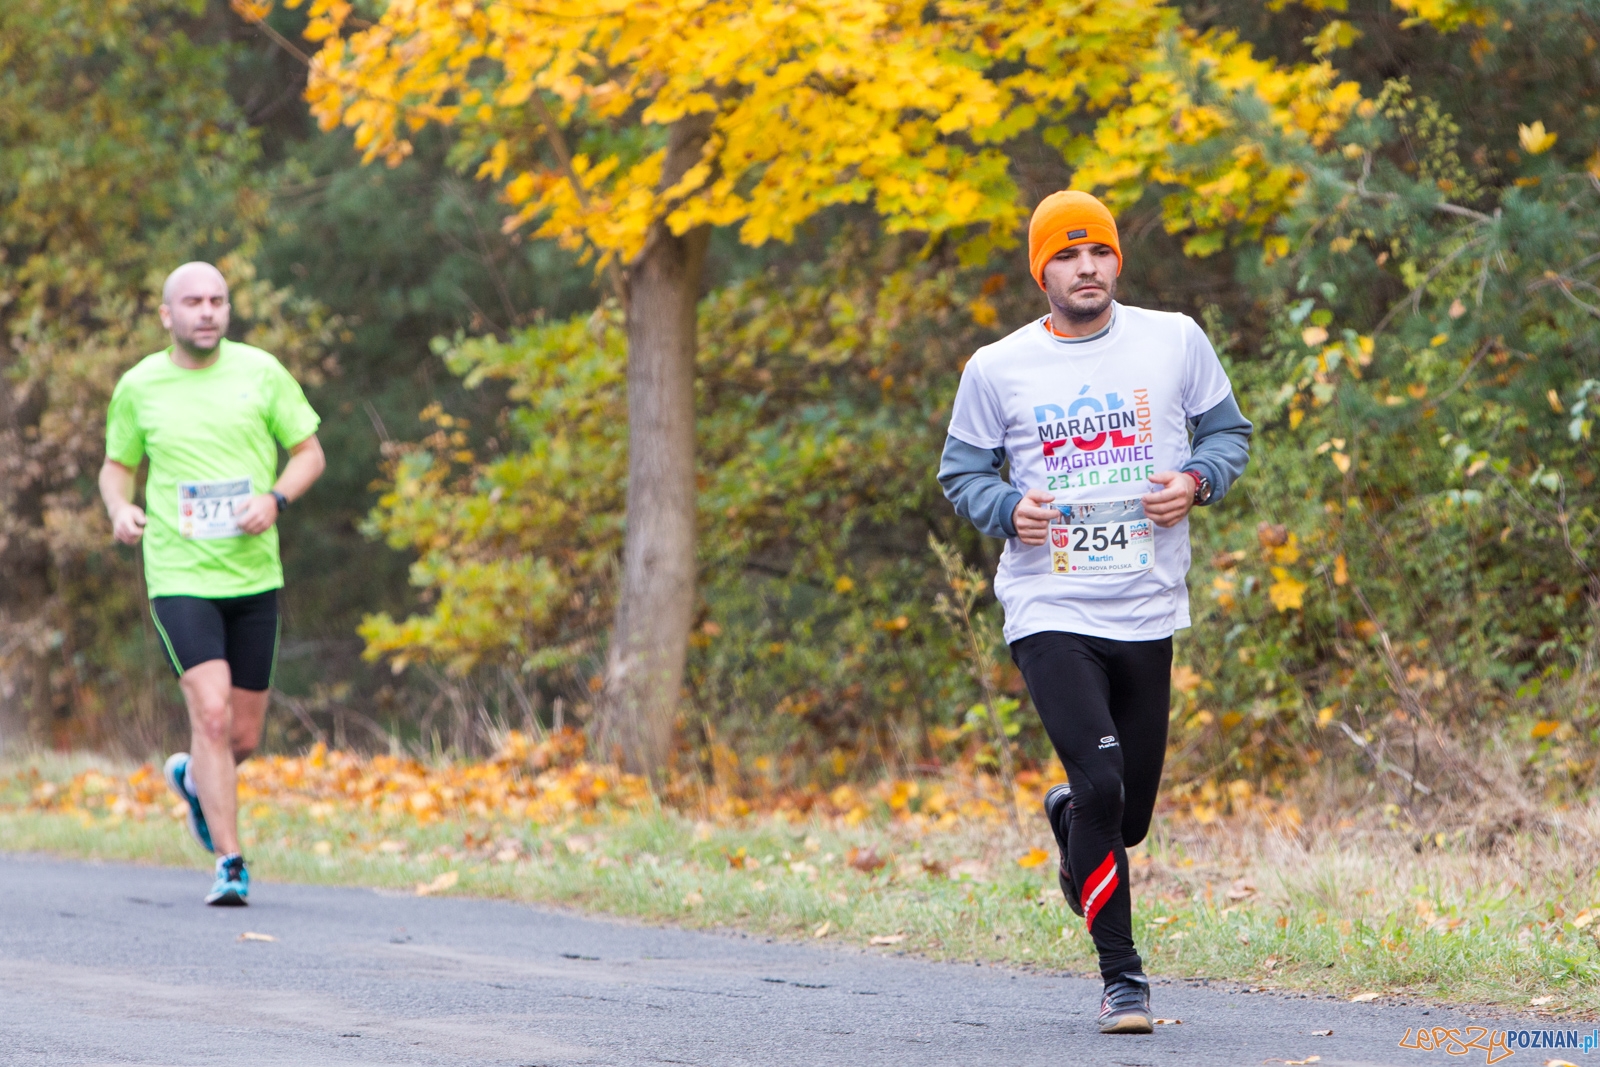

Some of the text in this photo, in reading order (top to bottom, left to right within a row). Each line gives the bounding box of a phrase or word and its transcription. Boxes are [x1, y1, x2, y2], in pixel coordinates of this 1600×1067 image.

[1038, 410, 1135, 442] MARATON
[1133, 388, 1152, 443] SKOKI
[1044, 445, 1154, 473] WĄGROWIEC
[1047, 464, 1155, 491] 23.10.2016
[197, 499, 235, 519] 371
[1072, 524, 1128, 552] 254
[1088, 554, 1114, 562] Martin
